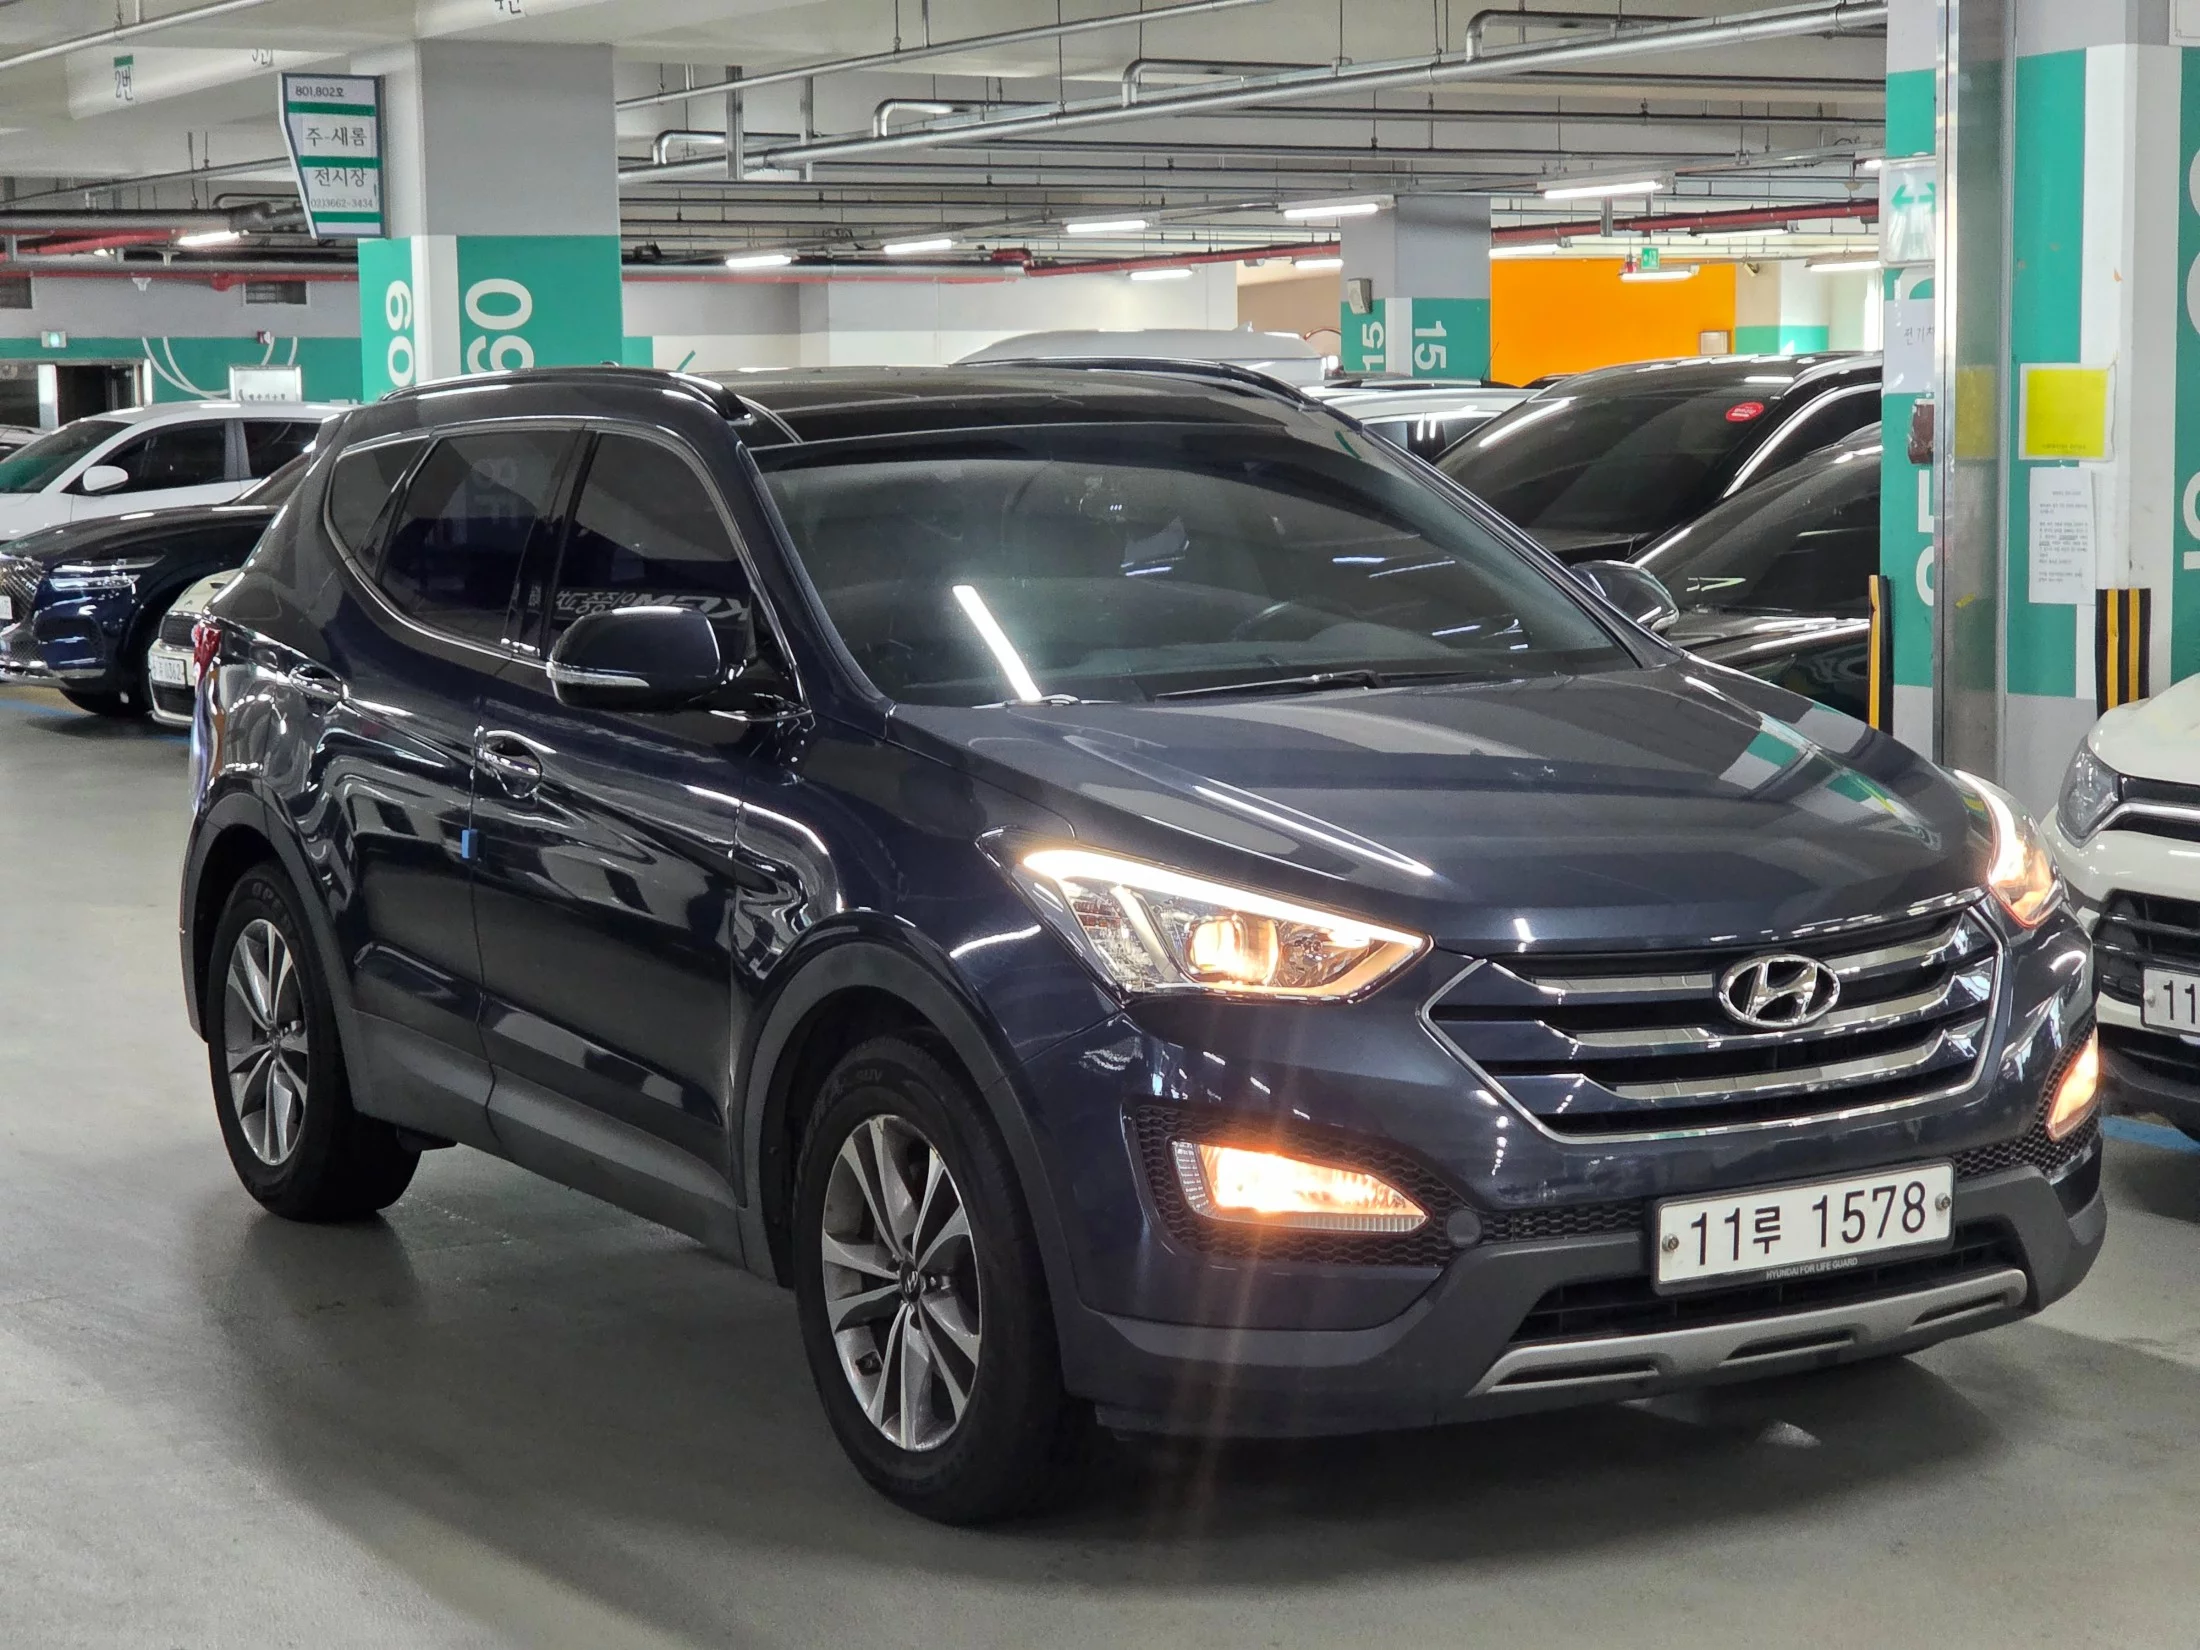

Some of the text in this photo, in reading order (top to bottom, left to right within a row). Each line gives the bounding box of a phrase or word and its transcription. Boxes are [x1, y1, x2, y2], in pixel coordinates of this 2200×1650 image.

[114, 66, 134, 101] 2번
[314, 168, 367, 188] 전시장
[1362, 321, 1384, 372] 15
[1414, 320, 1447, 370] 15
[1690, 1180, 1926, 1266] 11루 1578
[1766, 1257, 1858, 1280] HYUNDAI FOR LIFE GUARD
